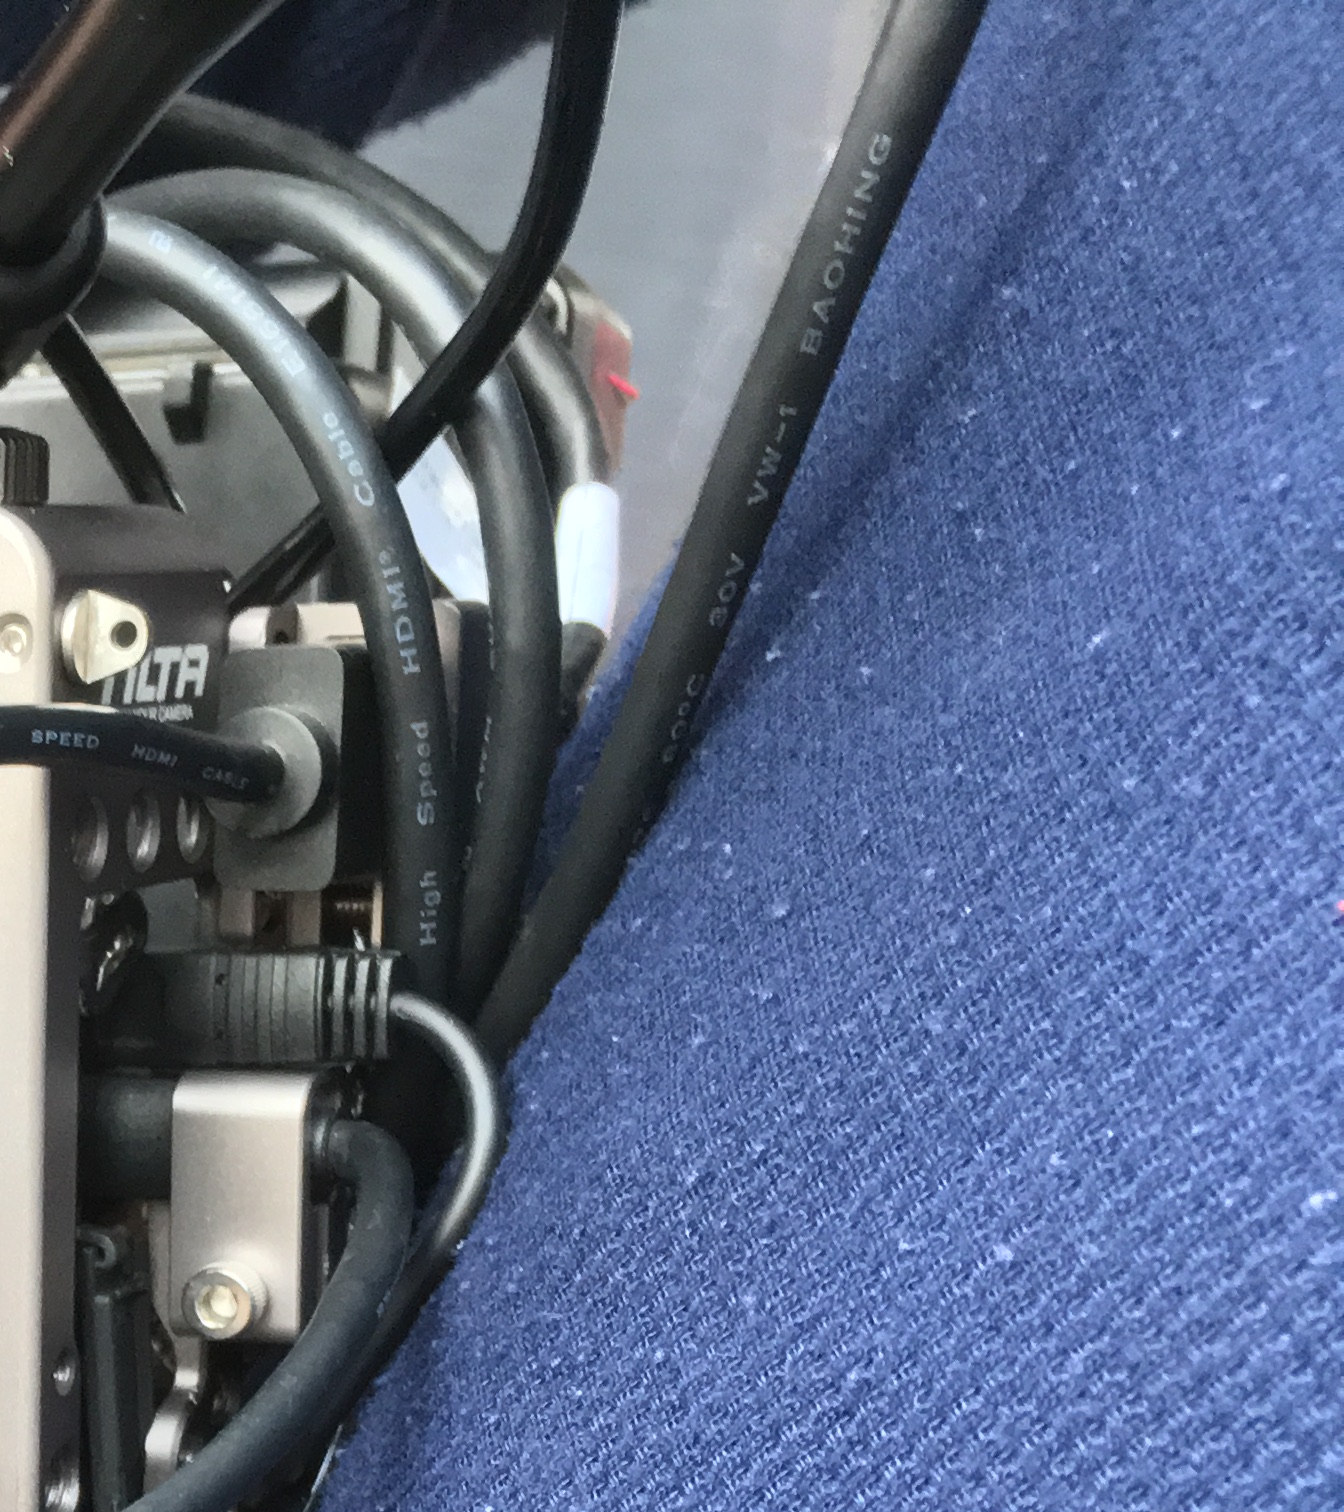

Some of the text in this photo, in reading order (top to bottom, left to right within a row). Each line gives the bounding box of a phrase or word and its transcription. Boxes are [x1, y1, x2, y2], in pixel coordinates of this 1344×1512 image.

[799, 132, 893, 356] BAOHING
[323, 411, 376, 508] Cable
[31, 728, 100, 750] SPEED
[410, 720, 438, 826] Speed
[419, 870, 442, 946] High
